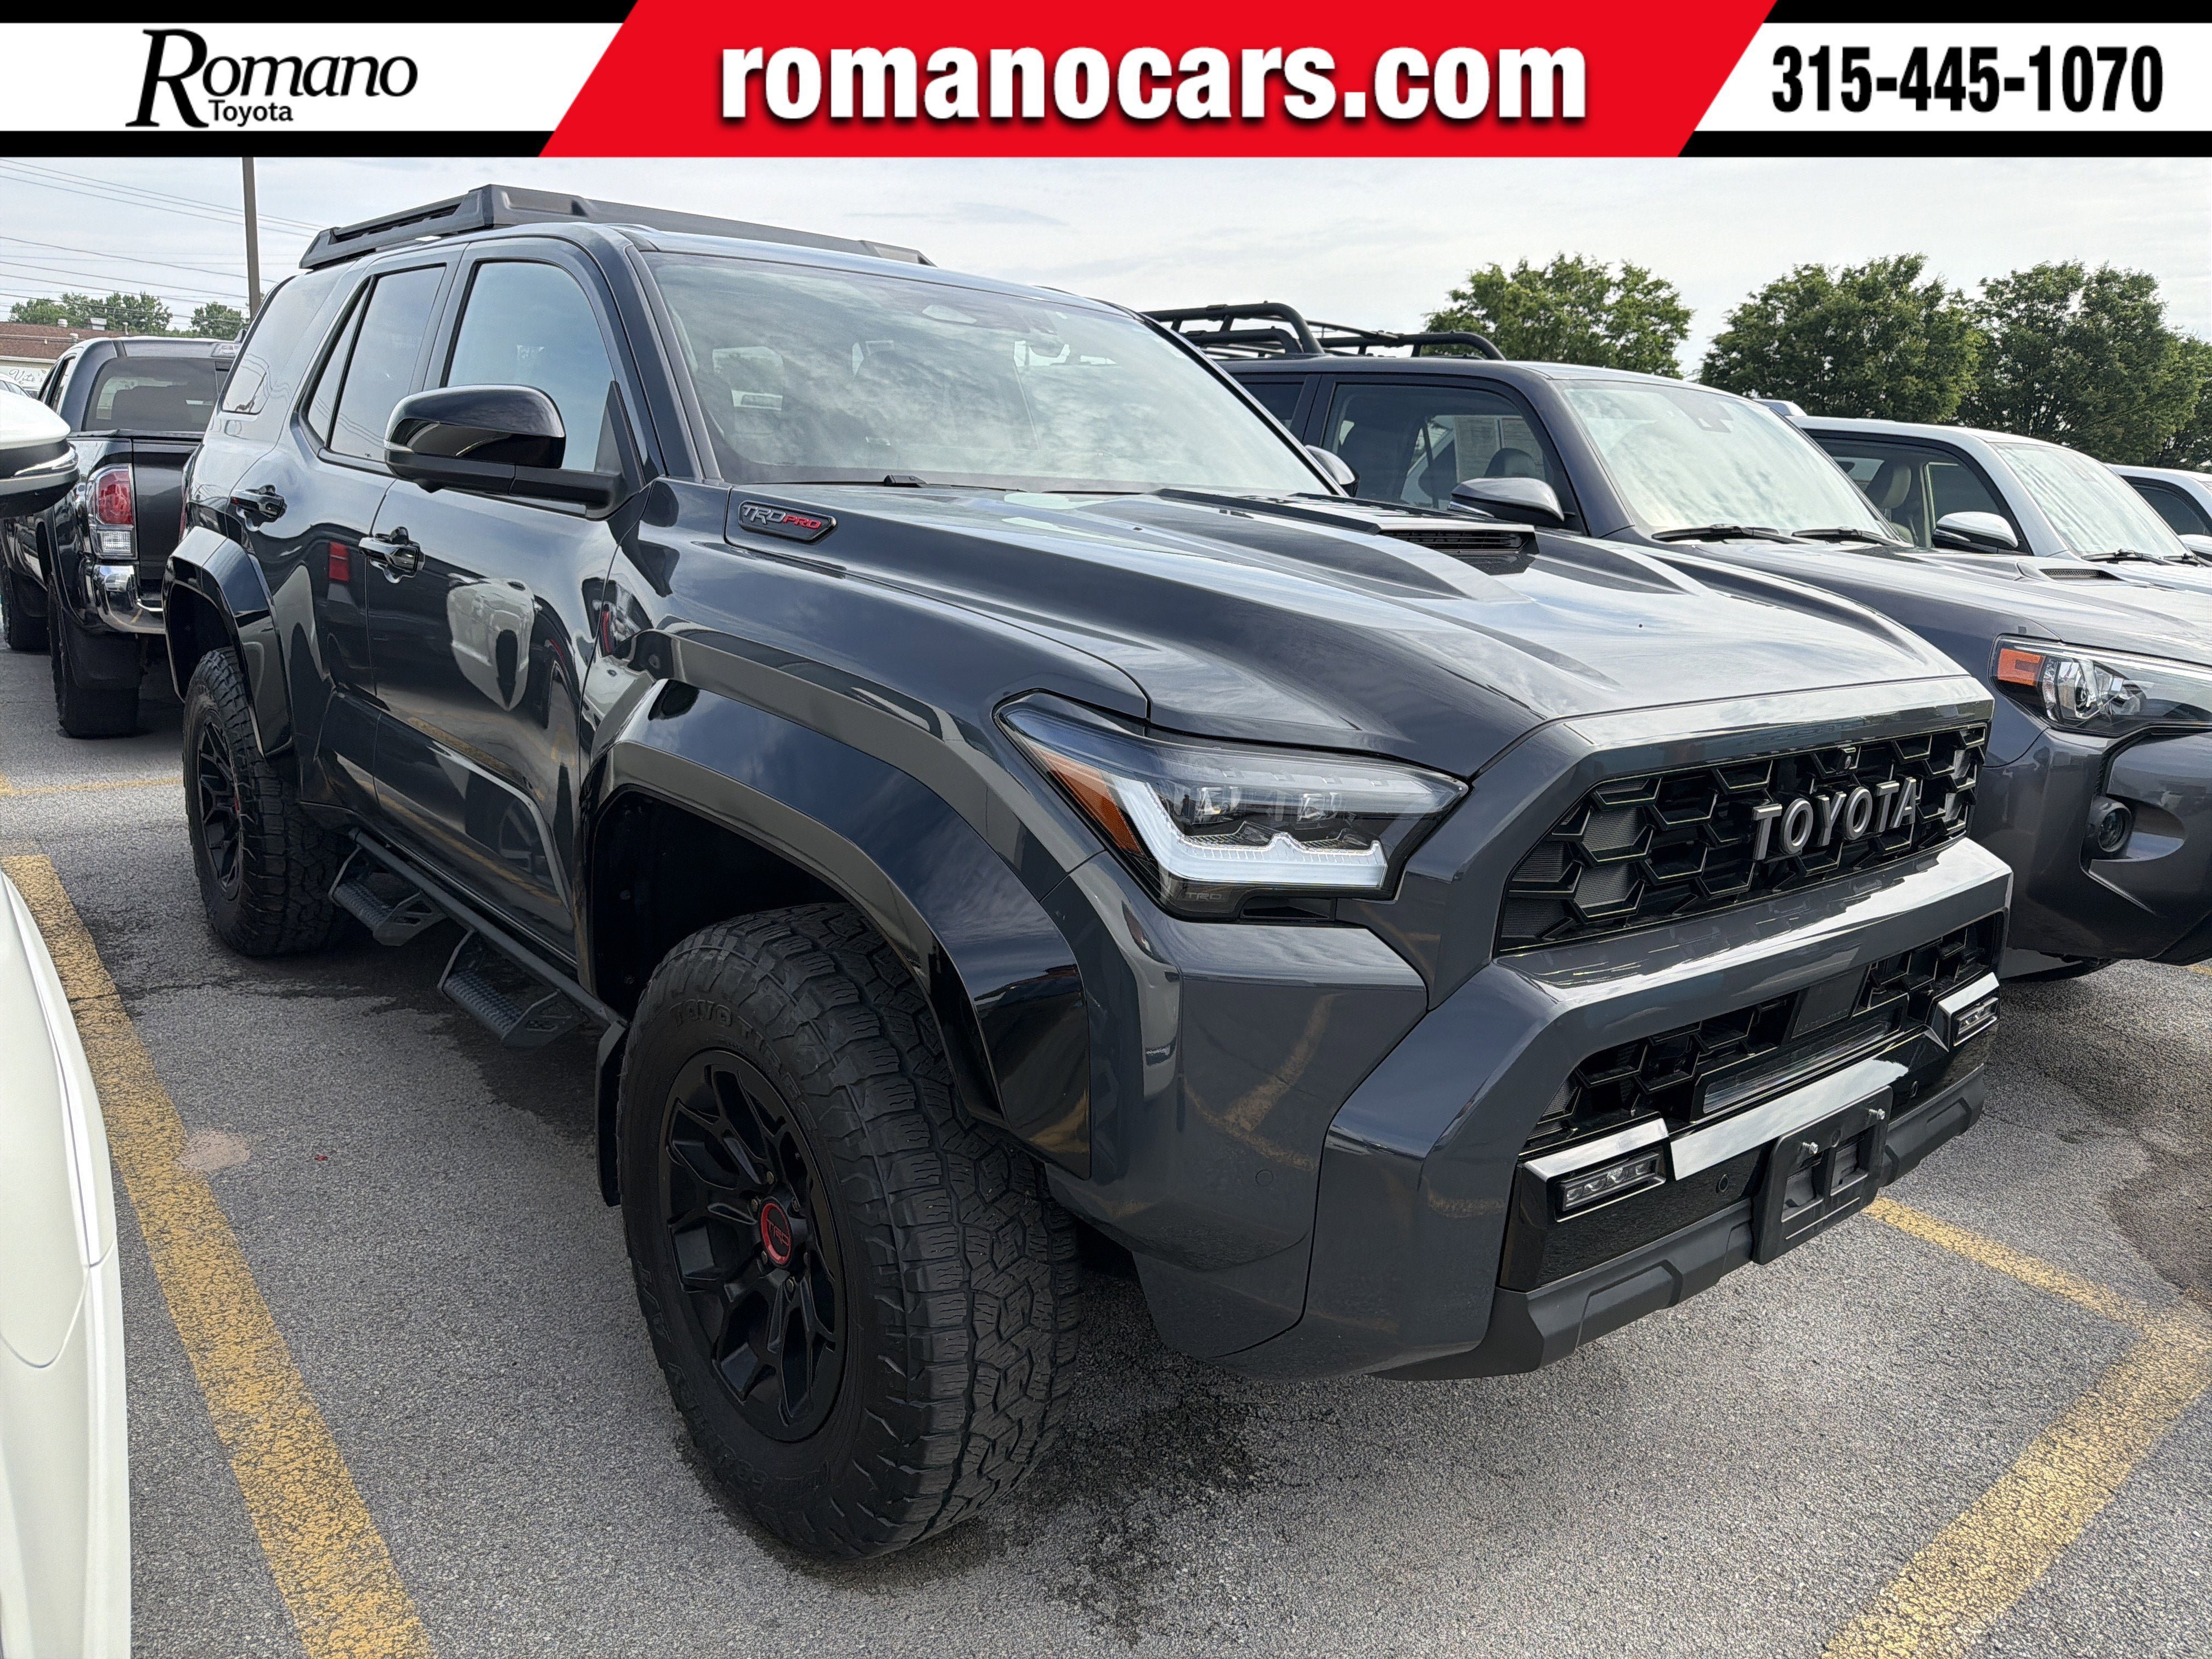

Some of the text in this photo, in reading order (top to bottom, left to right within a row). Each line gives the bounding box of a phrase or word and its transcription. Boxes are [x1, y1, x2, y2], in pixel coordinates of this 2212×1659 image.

[742, 504, 822, 529] TRD PRO
[1752, 776, 1917, 861] TOYOTA
[1184, 892, 1222, 901] TRD
[766, 1217, 790, 1247] TRD
